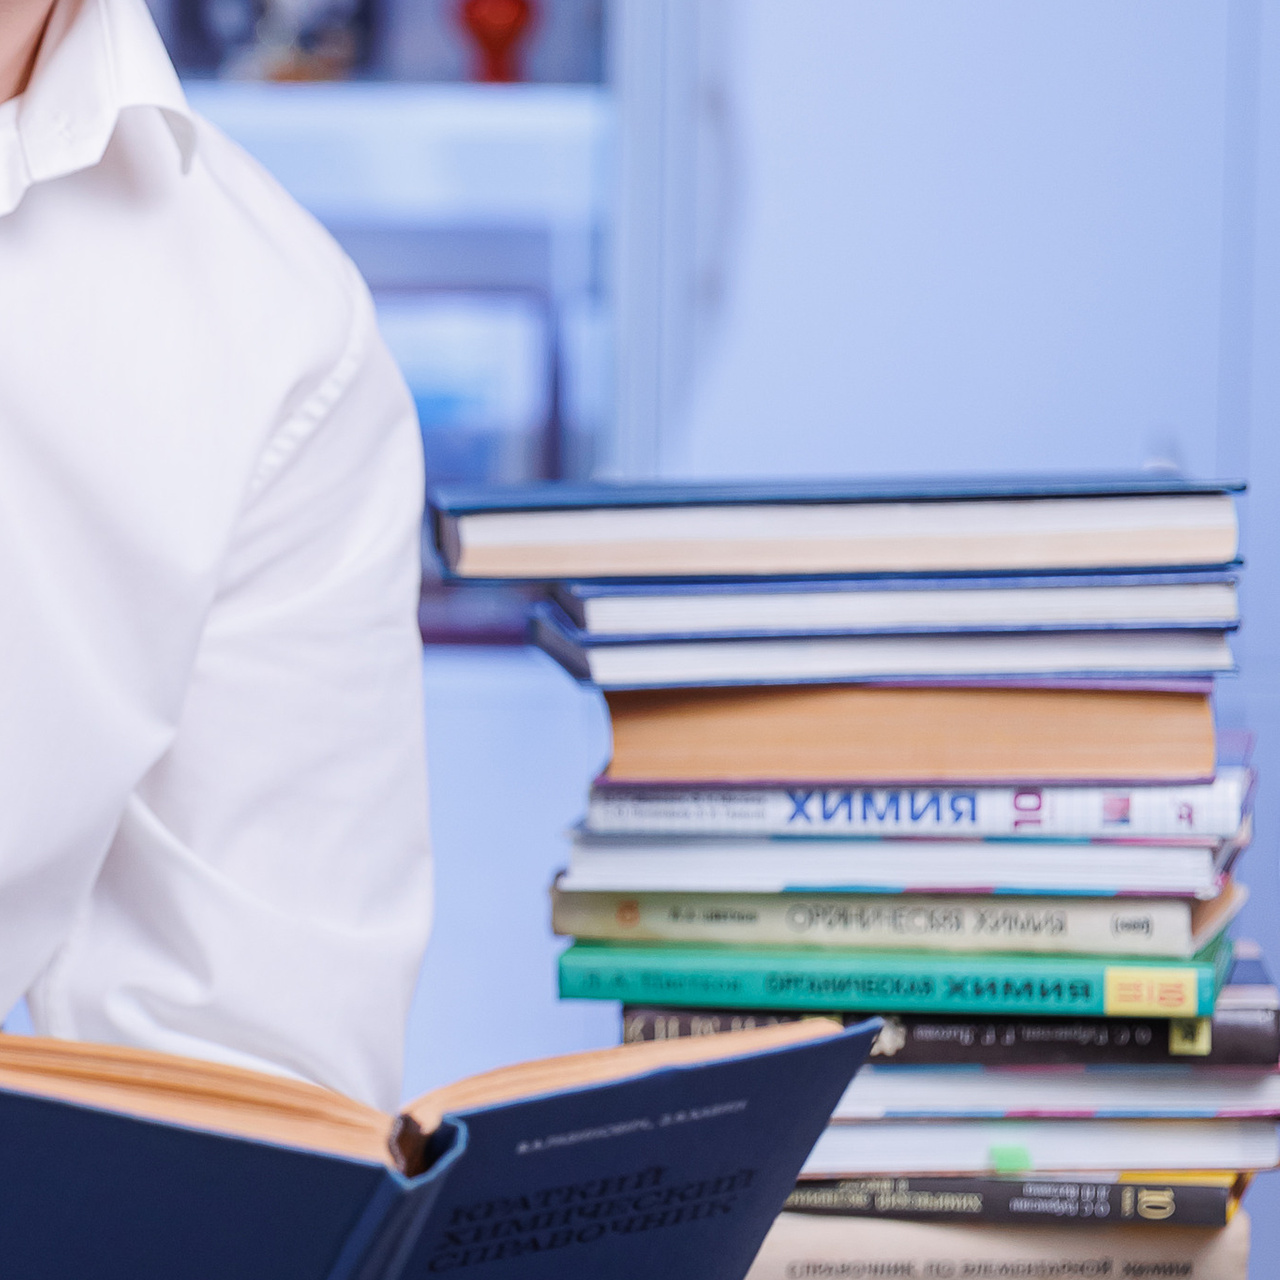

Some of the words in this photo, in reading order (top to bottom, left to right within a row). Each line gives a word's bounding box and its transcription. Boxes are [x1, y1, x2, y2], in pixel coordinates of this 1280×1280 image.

[785, 788, 977, 823] ХИМИЯ
[1014, 789, 1042, 831] 10
[765, 972, 933, 996] ОРГАНИЧЕСКАЯ
[946, 975, 1092, 1001] ХИМИЯ
[442, 1168, 758, 1249] ХИМИЧЕСКИЙ
[451, 1166, 666, 1224] КРАТКИЙ
[428, 1195, 738, 1273] СПРАВОЧНИК
